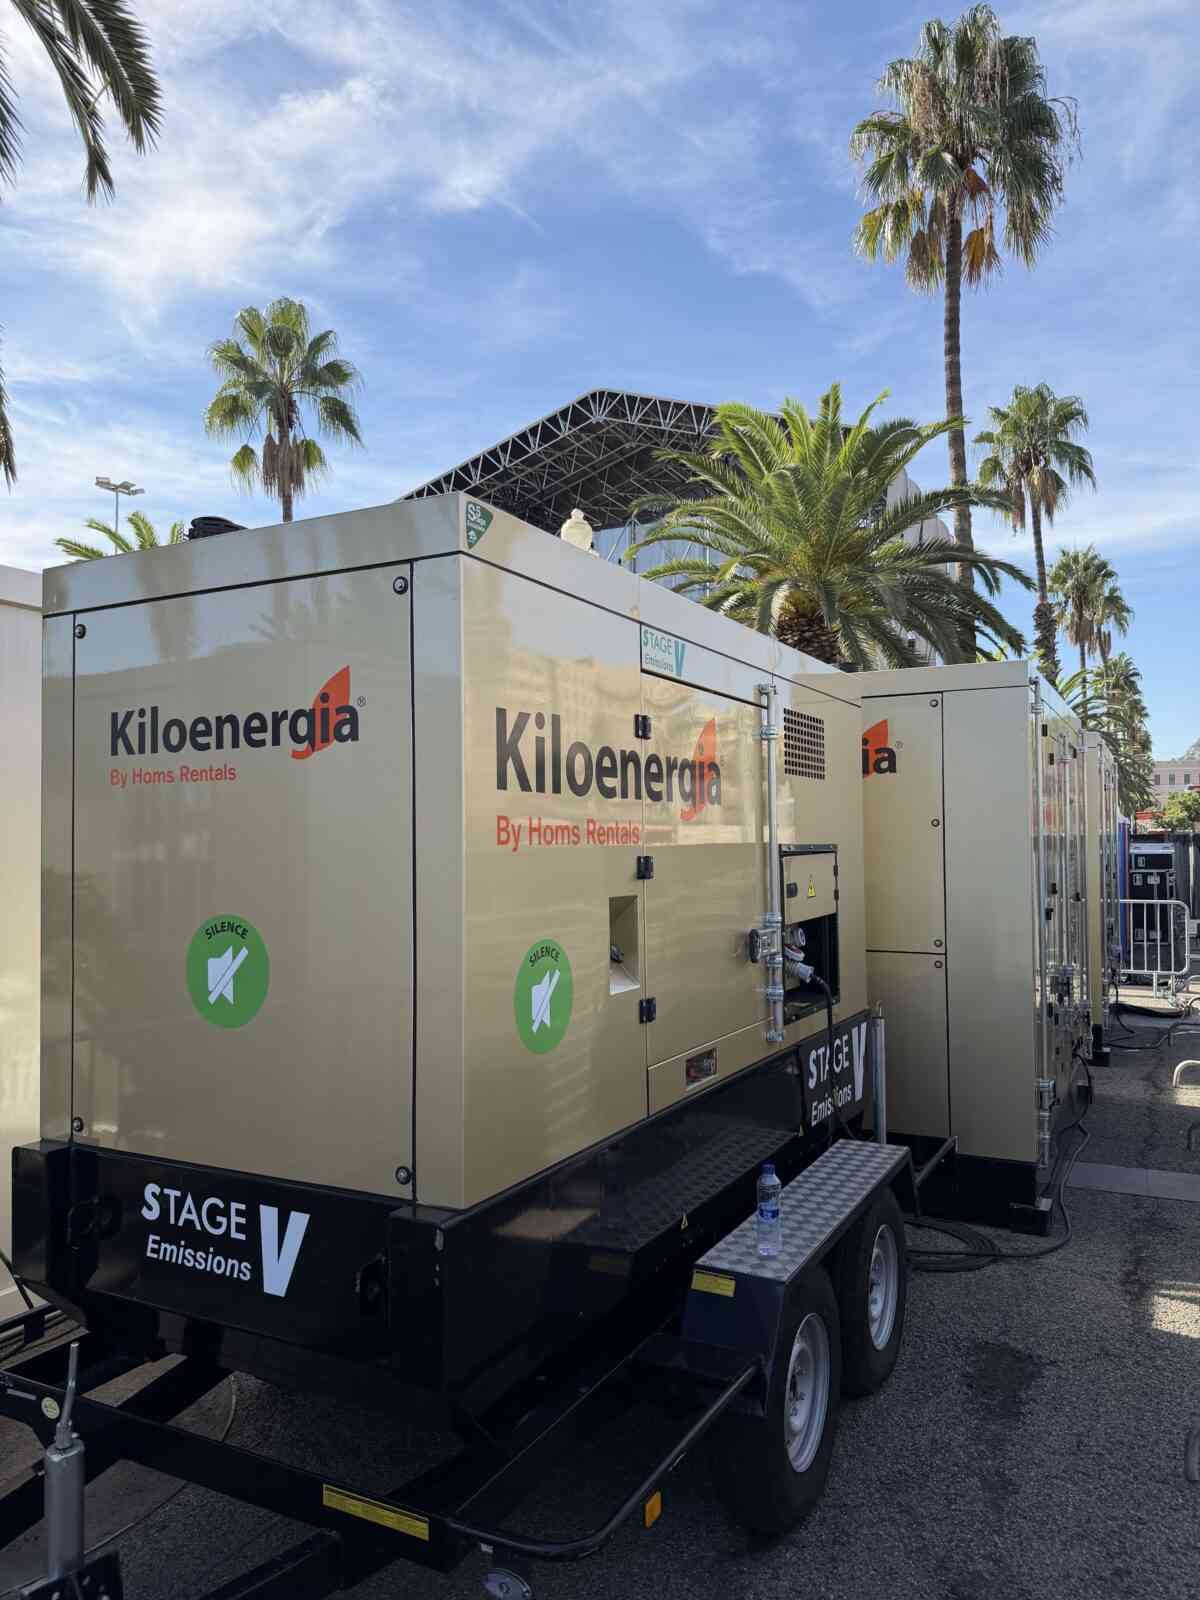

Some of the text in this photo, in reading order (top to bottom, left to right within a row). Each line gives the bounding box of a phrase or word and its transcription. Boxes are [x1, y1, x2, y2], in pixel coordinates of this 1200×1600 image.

[642, 629, 686, 677] STAGE V
[109, 763, 237, 789] By Homs Rentals
[496, 815, 641, 852] By Homs Rentals
[205, 921, 249, 940] SILENCE
[528, 945, 561, 967] SILENCE
[851, 1021, 867, 1102] V
[141, 1183, 311, 1298] STAGE V
[146, 1234, 252, 1281] Emissions
